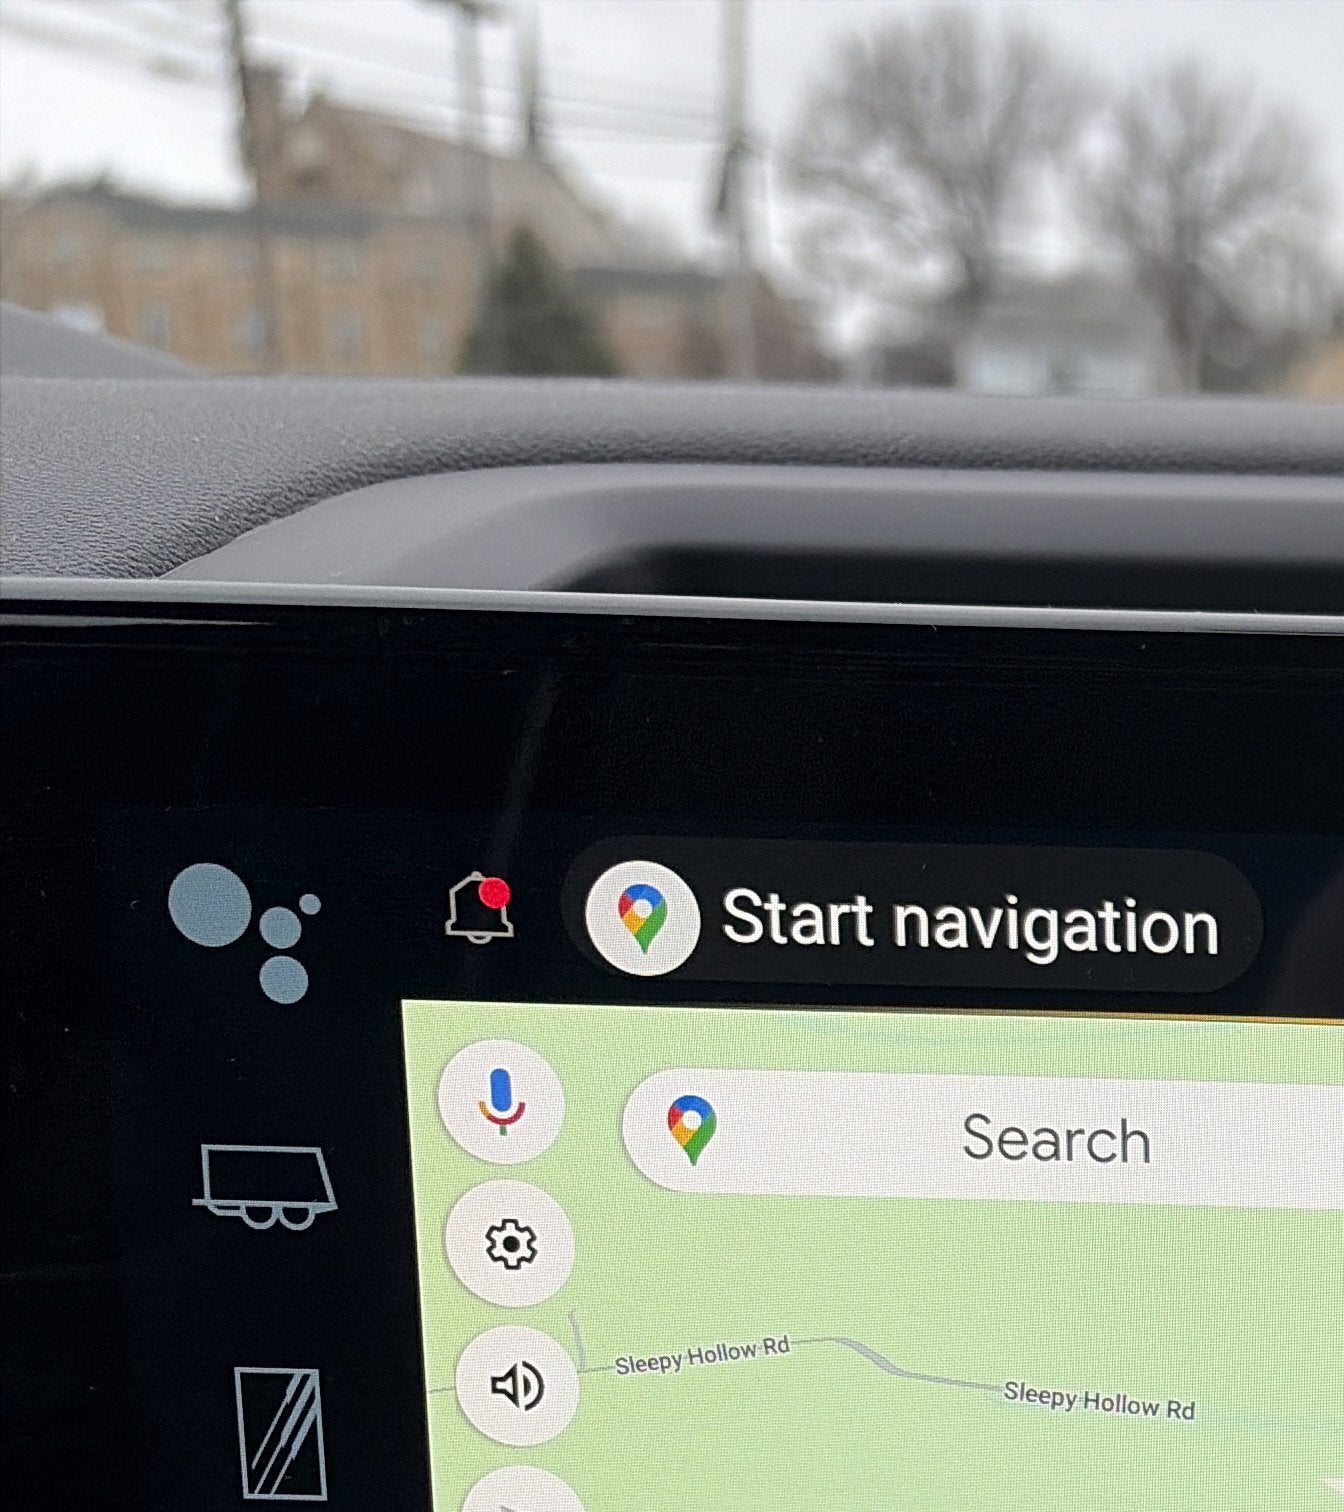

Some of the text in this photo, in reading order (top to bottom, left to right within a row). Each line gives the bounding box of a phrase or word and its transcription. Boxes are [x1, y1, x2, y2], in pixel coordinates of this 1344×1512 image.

[722, 888, 1220, 965] Start navigation
[962, 1113, 1151, 1164] Search
[615, 1336, 790, 1378] Sleepy Hollow Rd
[1004, 1381, 1196, 1421] Sleepy Hollow Rd
